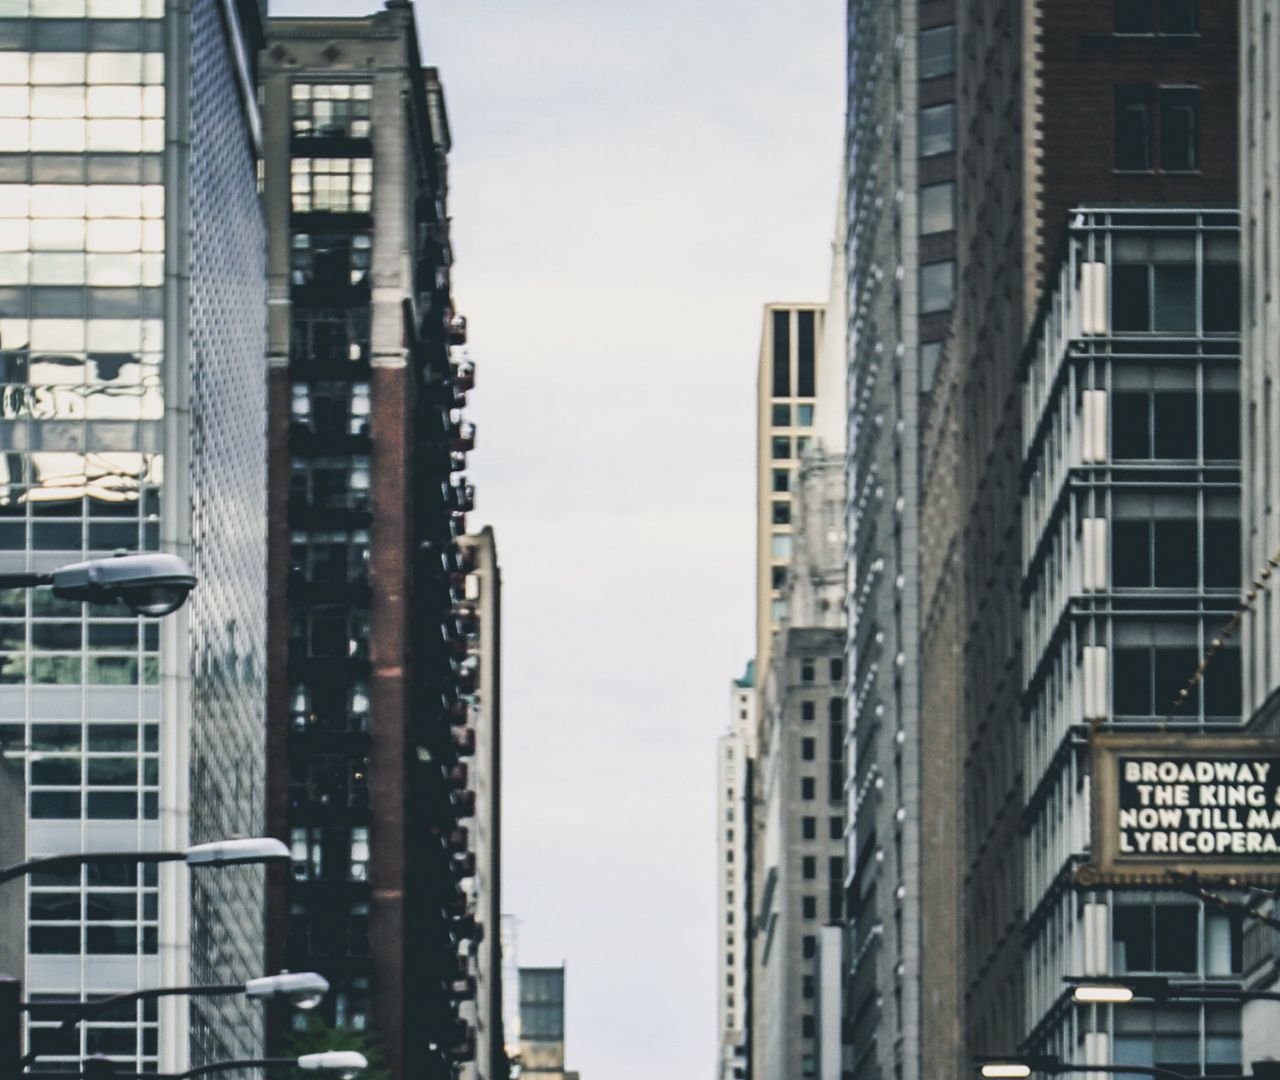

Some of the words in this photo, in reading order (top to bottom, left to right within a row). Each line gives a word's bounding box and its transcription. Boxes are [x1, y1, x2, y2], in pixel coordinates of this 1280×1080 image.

[1125, 761, 1270, 783] BROADWAY
[1137, 785, 1190, 806] THE
[1199, 785, 1266, 806] KING
[1118, 808, 1183, 830] NOW
[1185, 808, 1244, 830] TILL
